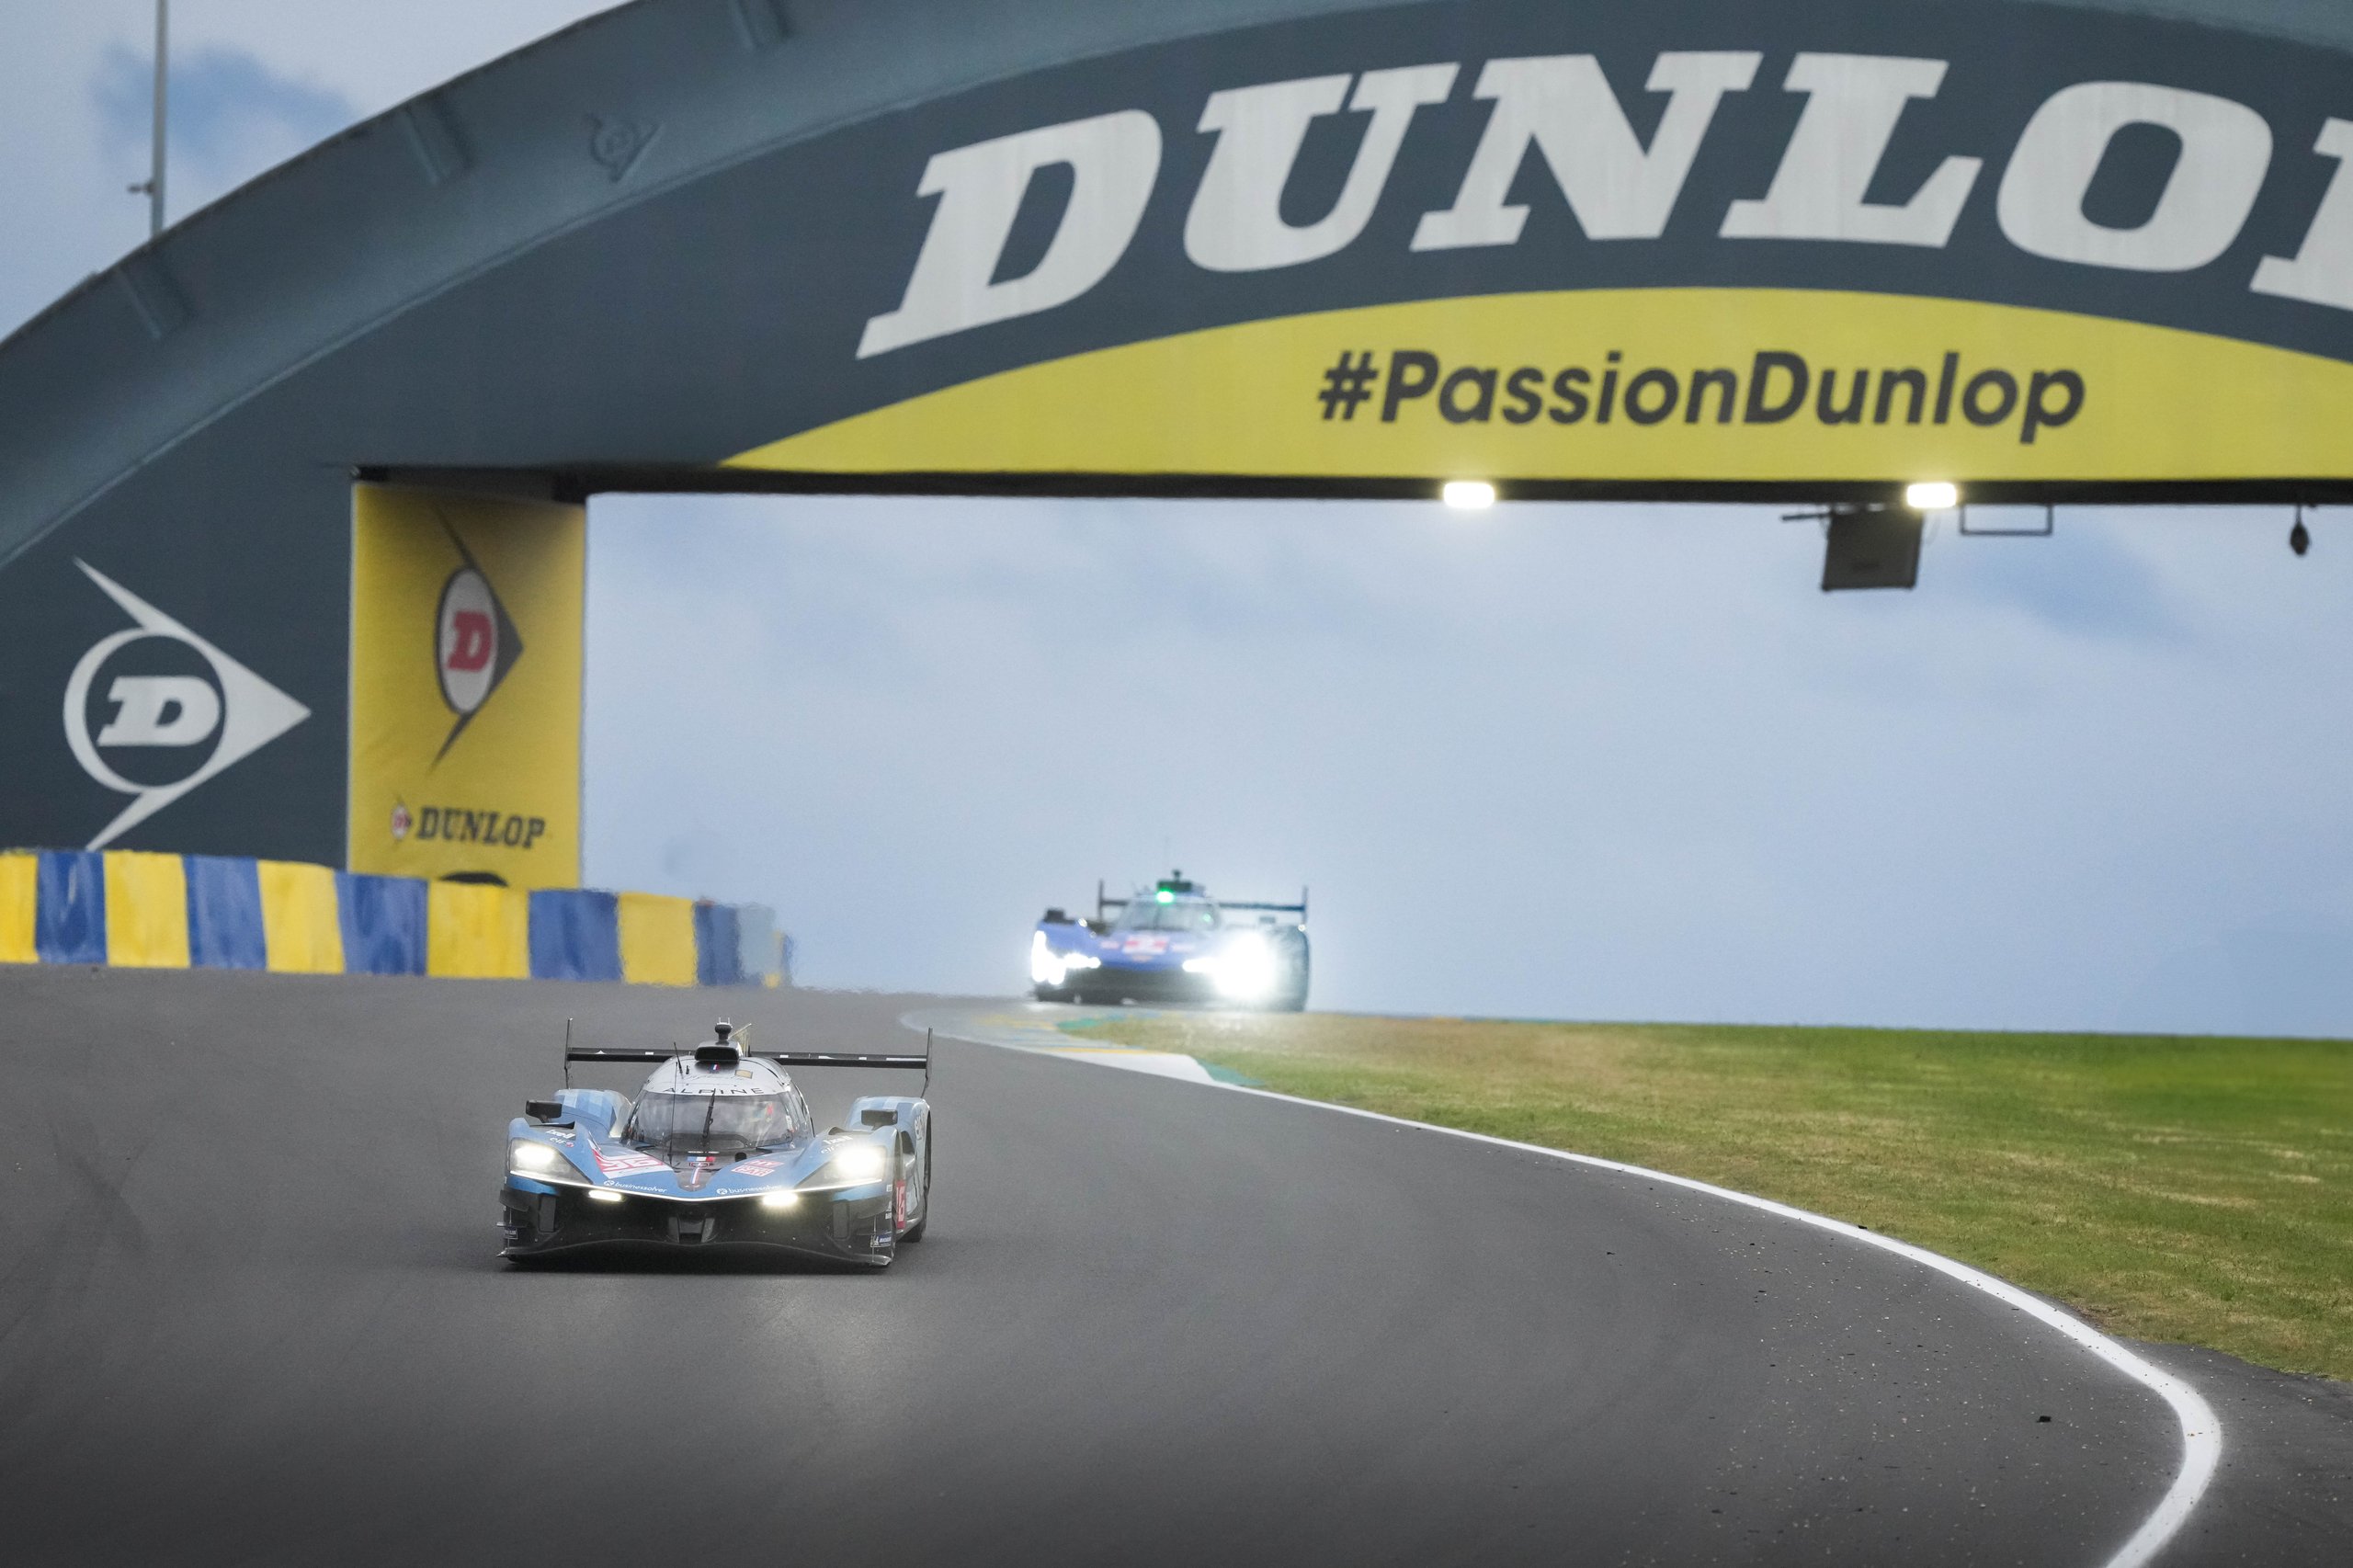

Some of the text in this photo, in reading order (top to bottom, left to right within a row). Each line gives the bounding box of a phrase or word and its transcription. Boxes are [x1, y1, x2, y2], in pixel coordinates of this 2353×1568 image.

[1318, 349, 2086, 445] #PassionDunlop
[445, 610, 494, 672] D
[97, 676, 221, 746] D
[416, 805, 546, 850] DUNLOP
[614, 1181, 668, 1193] businessolver
